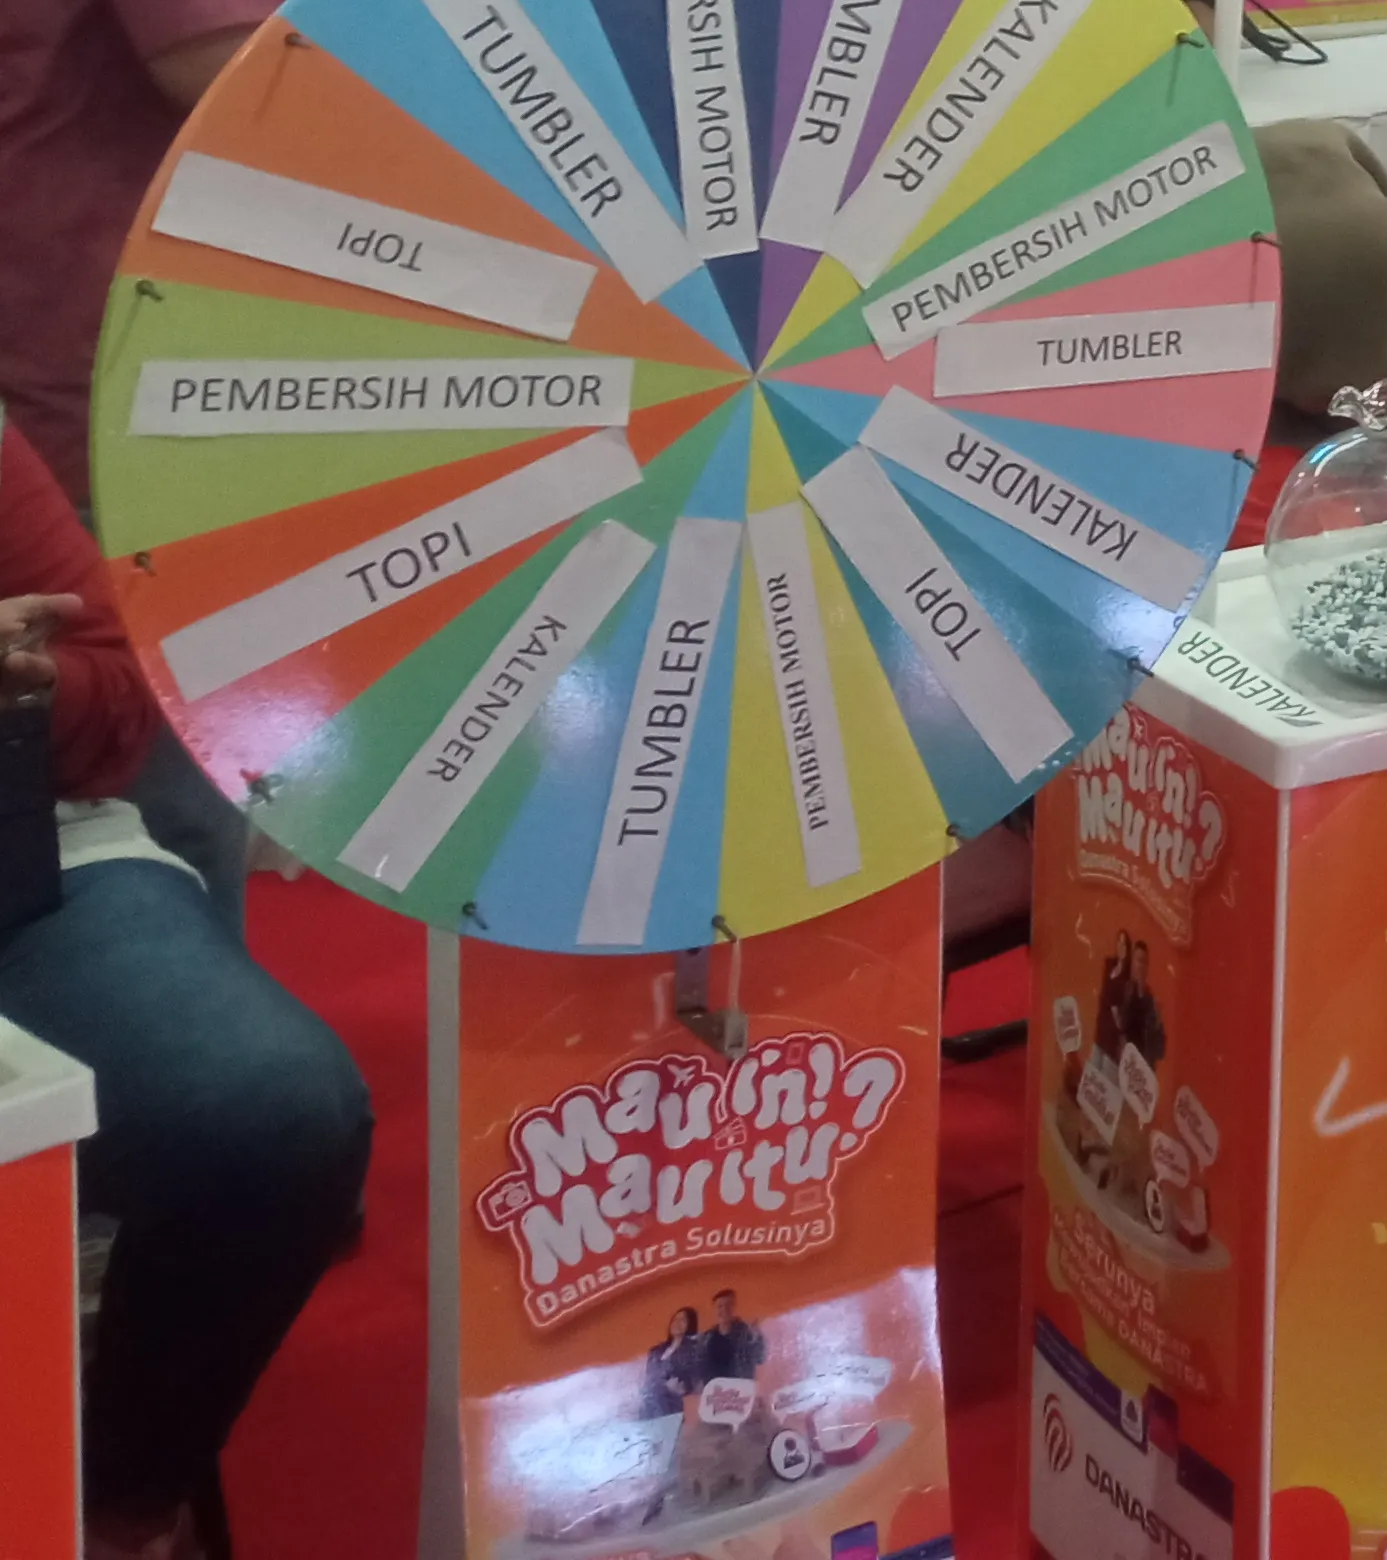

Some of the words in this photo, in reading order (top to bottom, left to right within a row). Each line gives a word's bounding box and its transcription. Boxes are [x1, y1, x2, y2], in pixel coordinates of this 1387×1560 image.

[463, 6, 623, 217] TUMBLER
[695, 86, 738, 231] MOTOR
[337, 222, 424, 273] TOPI
[891, 211, 1088, 334] PEMBERSIH
[1095, 144, 1218, 222] MOTOR
[170, 375, 428, 413] PEMBERSIH
[445, 374, 603, 409] MOTOR
[1037, 329, 1182, 367] TUMBLER
[944, 432, 1138, 561] KALENDER
[346, 522, 475, 603] TOPI
[767, 572, 803, 669] MOTOR
[905, 567, 983, 662] TOPI
[425, 615, 568, 784] KALENDER
[1178, 631, 1316, 719] KALENDER
[618, 618, 711, 846] TUMBLER
[784, 673, 829, 831] PEMBERSIH
[1078, 771, 1146, 857] Mau
[520, 1070, 716, 1197] Mau
[520, 1152, 712, 1285] Mau
[535, 1239, 677, 1316] Danastra
[686, 1219, 825, 1252] Solusinya
[1074, 1223, 1156, 1316] Serunya
